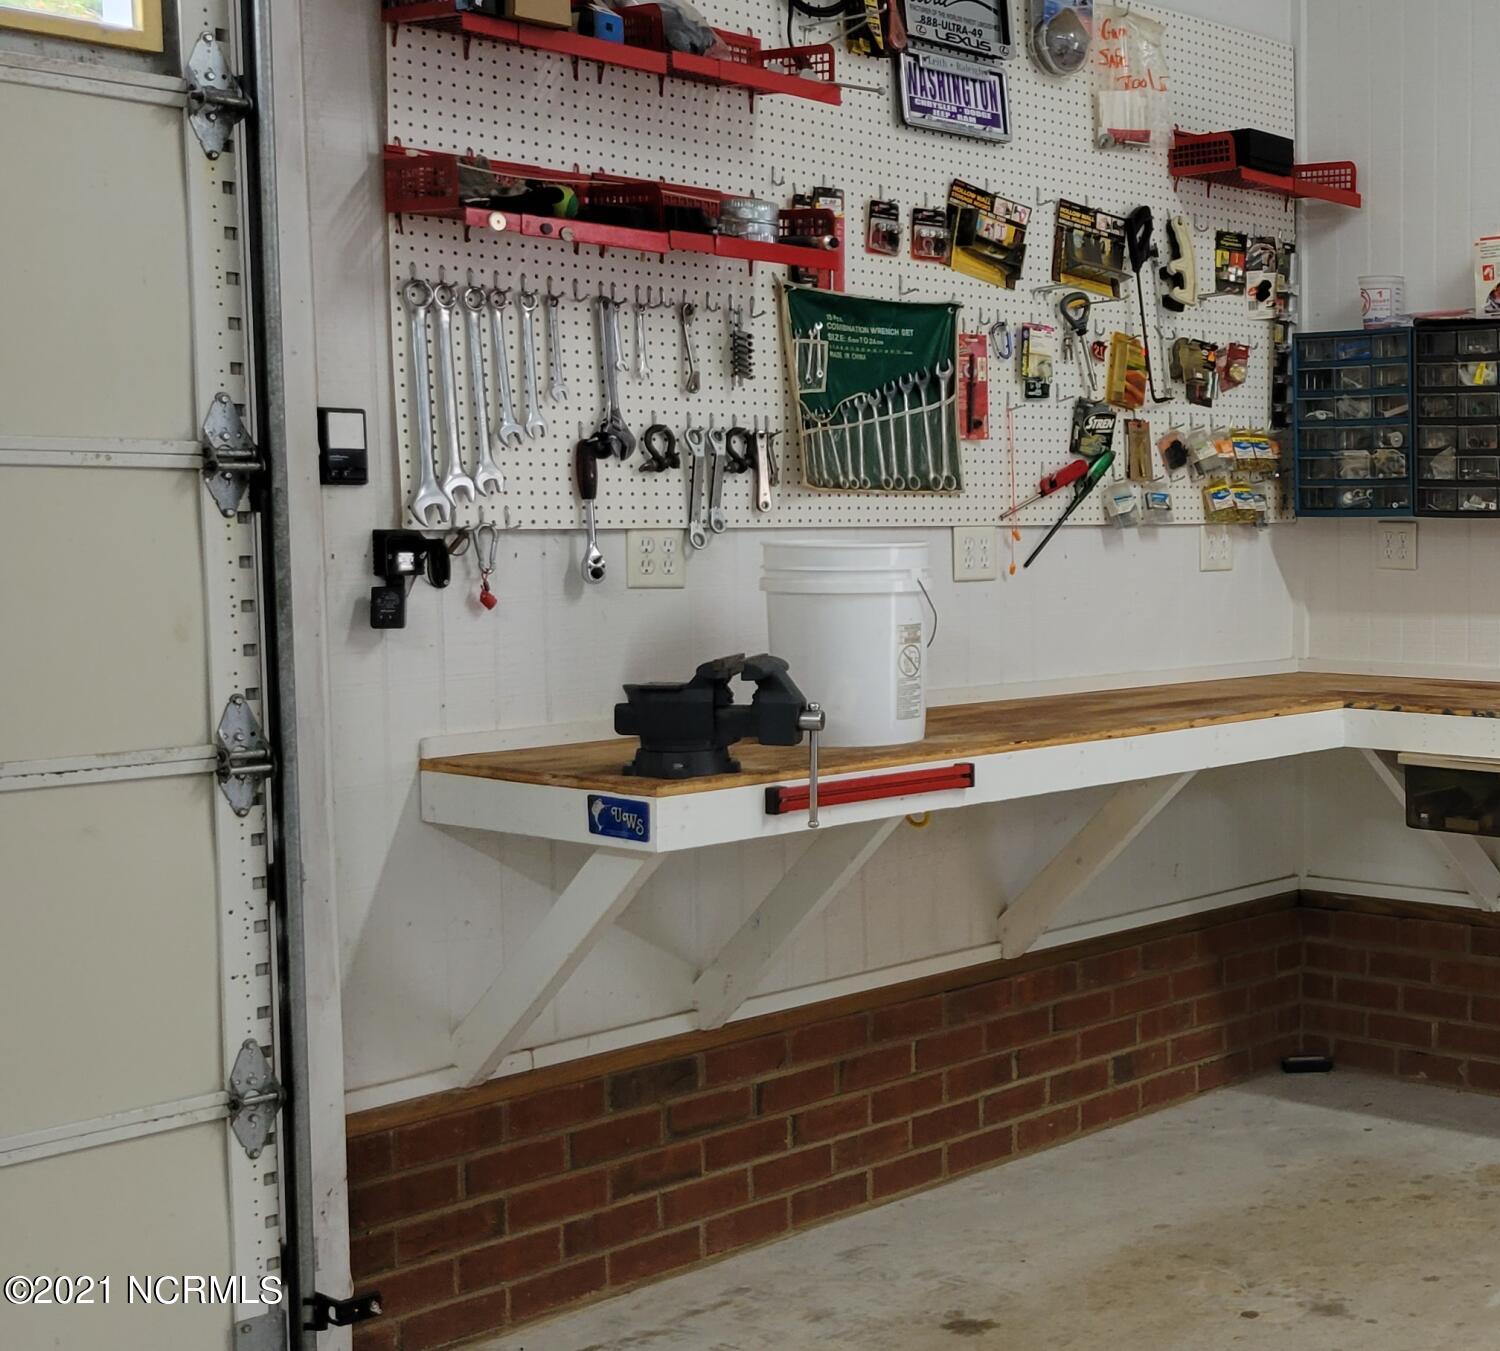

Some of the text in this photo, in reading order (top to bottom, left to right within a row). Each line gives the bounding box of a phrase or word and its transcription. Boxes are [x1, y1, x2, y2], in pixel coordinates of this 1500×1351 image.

[935, 29, 991, 51] LEXUS
[907, 60, 999, 112] WASHINGTON
[914, 98, 992, 120] CHRYSLER DODGE
[826, 321, 914, 337] COMBINATION WRENCH SET
[1085, 416, 1115, 430] STREN
[611, 806, 644, 836] UWS
